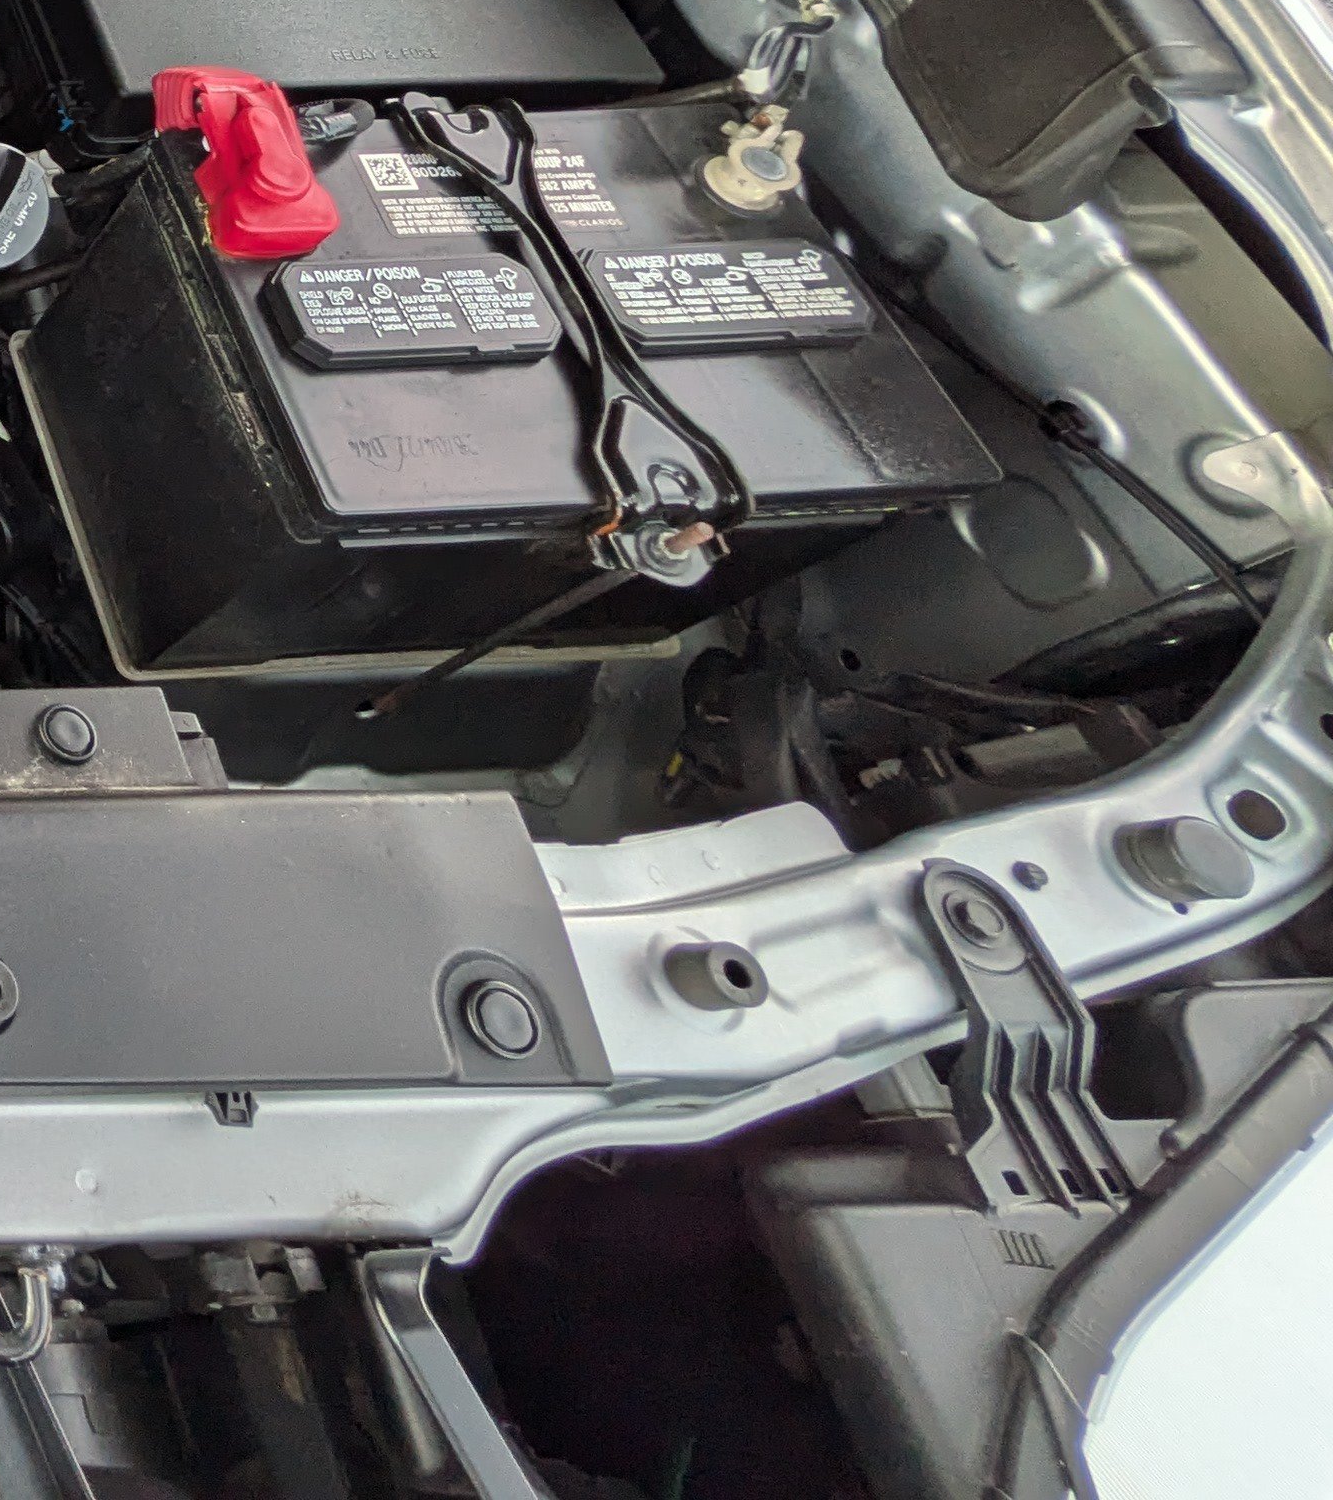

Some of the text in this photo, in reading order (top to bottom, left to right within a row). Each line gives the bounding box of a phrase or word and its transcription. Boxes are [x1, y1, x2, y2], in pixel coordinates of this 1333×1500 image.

[330, 48, 440, 61] RELAY & FUSE
[562, 155, 584, 167] 24F
[411, 166, 462, 178] 80D26
[561, 180, 596, 190] AMPS
[549, 201, 616, 213] 125 MINUTES
[617, 256, 669, 269] DANGER
[676, 253, 726, 266] POISON
[314, 266, 421, 283] DANGER / POISON
[435, 294, 453, 302] ACID
